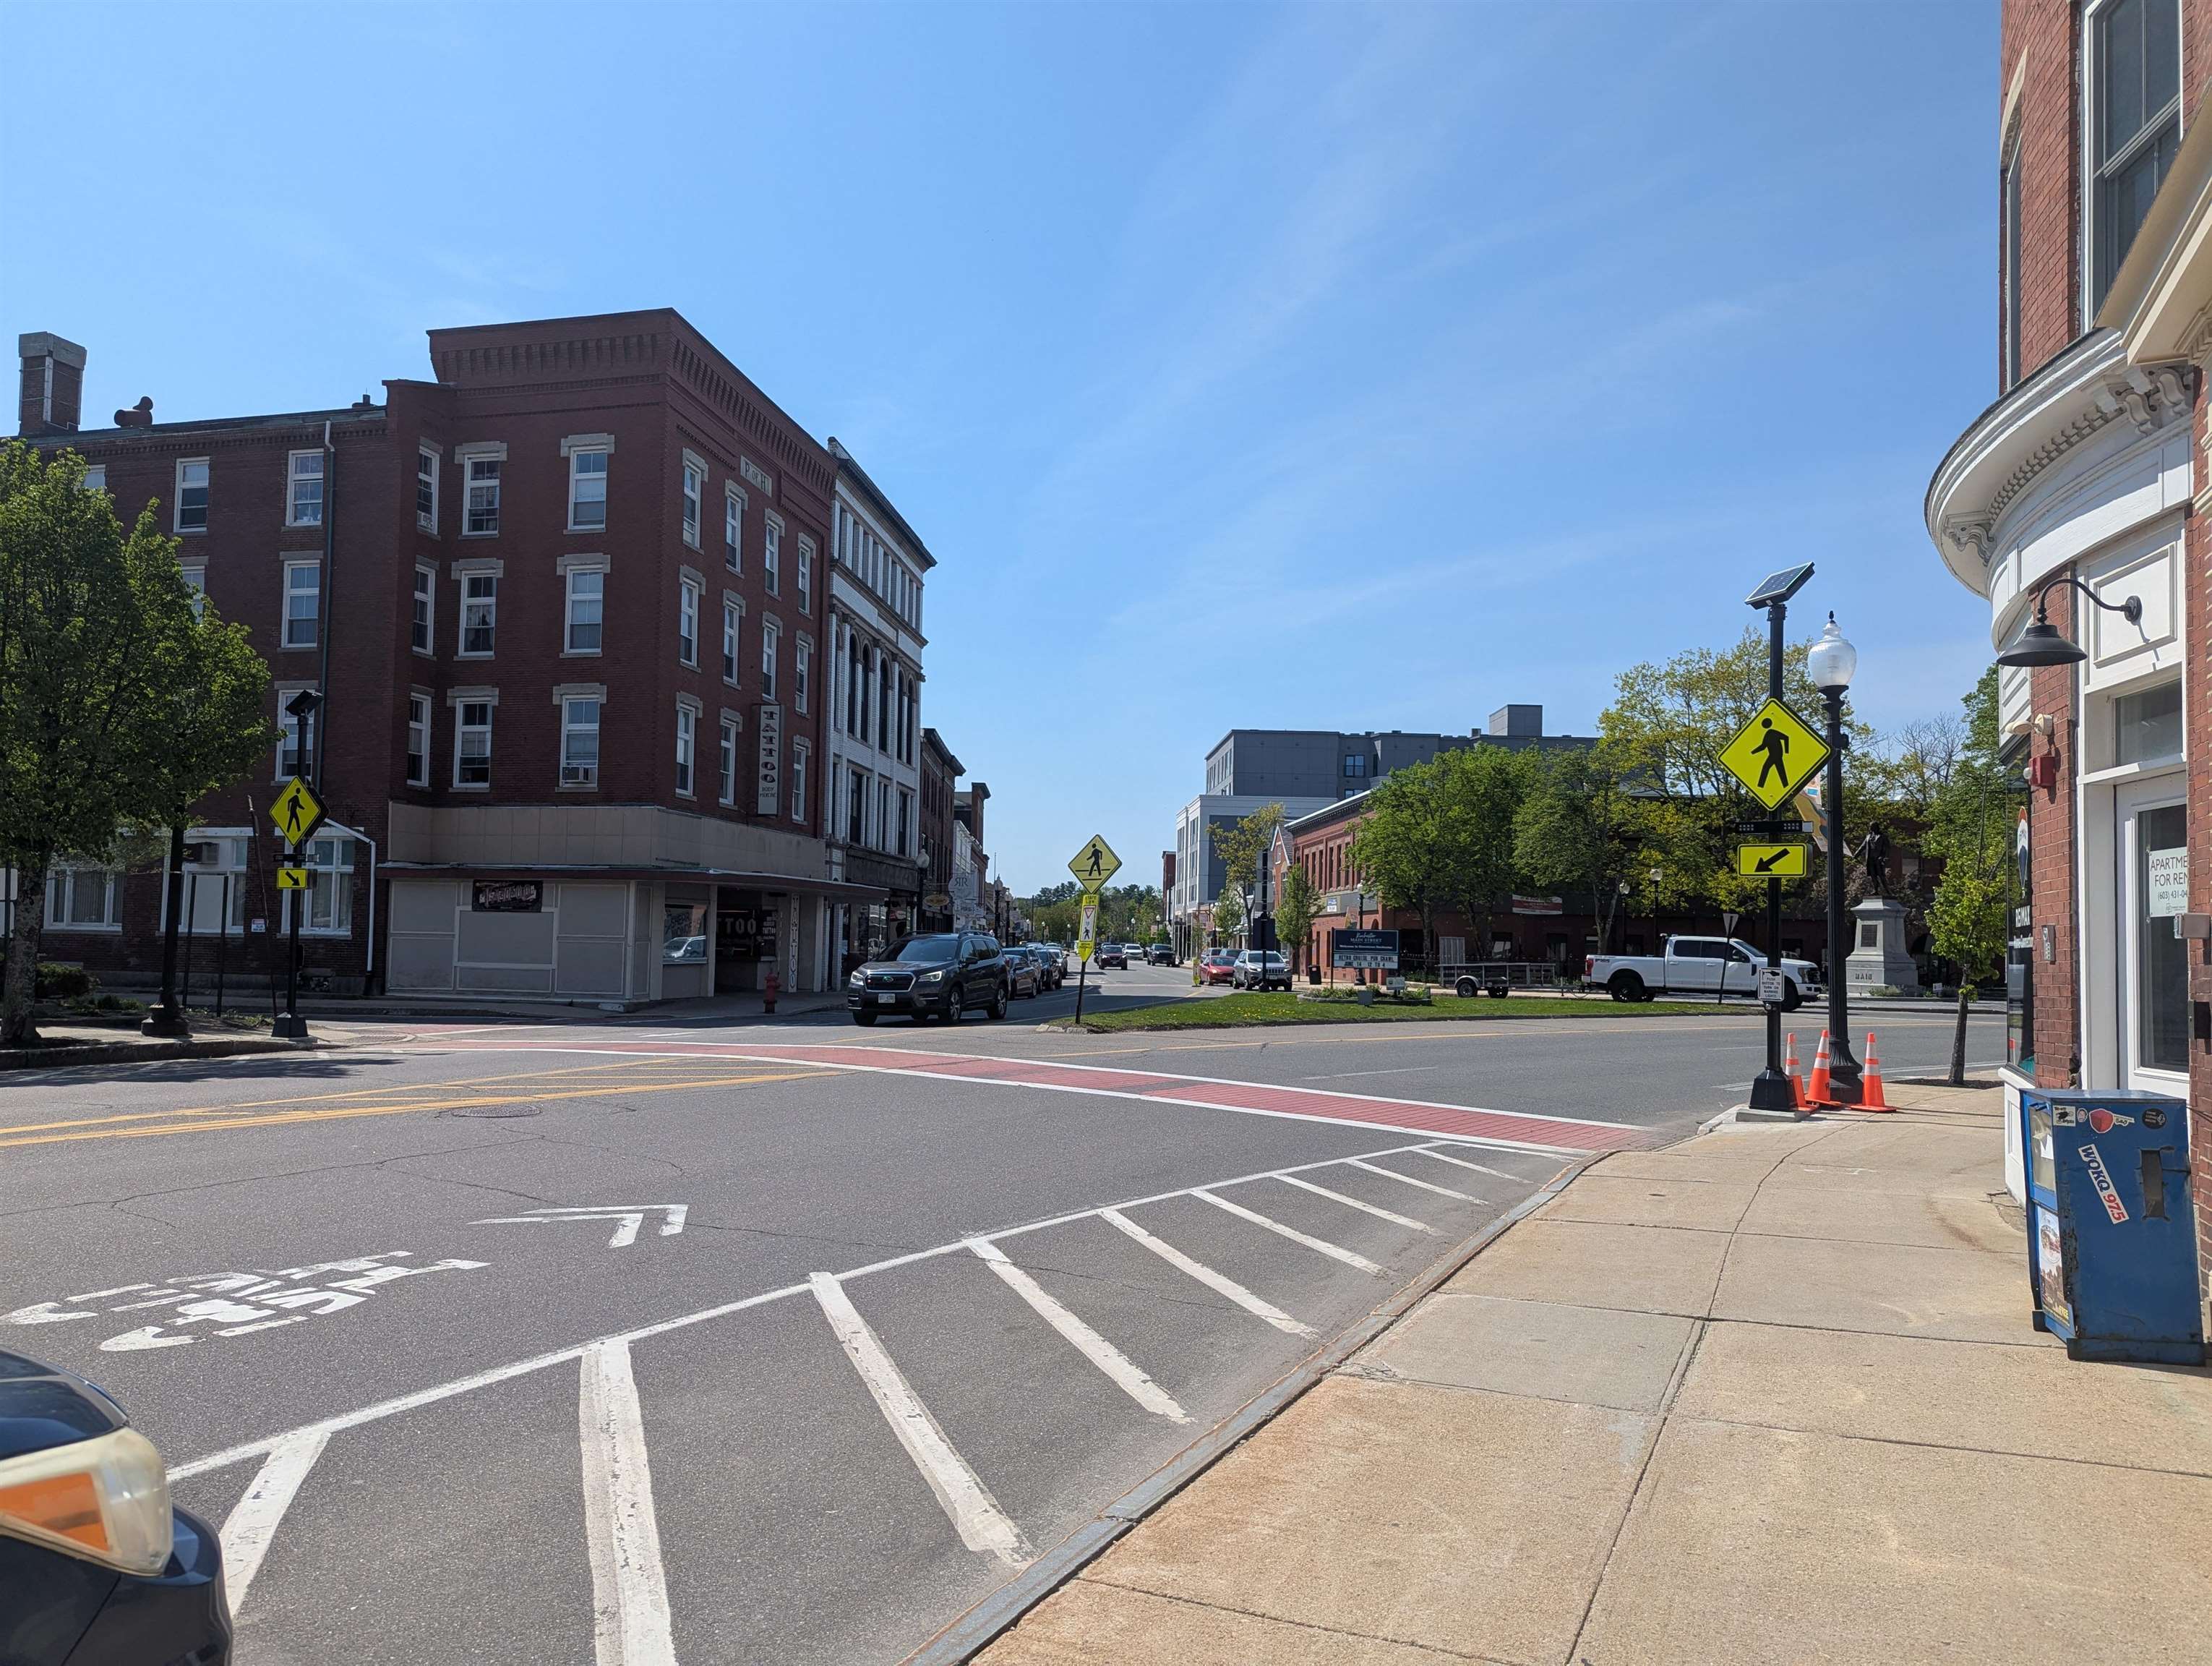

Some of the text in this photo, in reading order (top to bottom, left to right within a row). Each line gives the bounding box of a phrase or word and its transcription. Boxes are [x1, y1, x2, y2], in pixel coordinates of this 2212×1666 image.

[761, 710, 779, 784] TATTOO
[2151, 855, 2187, 871] APARTME
[2155, 872, 2187, 887] FOR REN
[2158, 891, 2170, 902] (603)
[716, 917, 757, 935] TTOO
[789, 897, 799, 988] TATTOO
[2081, 1145, 2126, 1221] WOKQ 97.5
